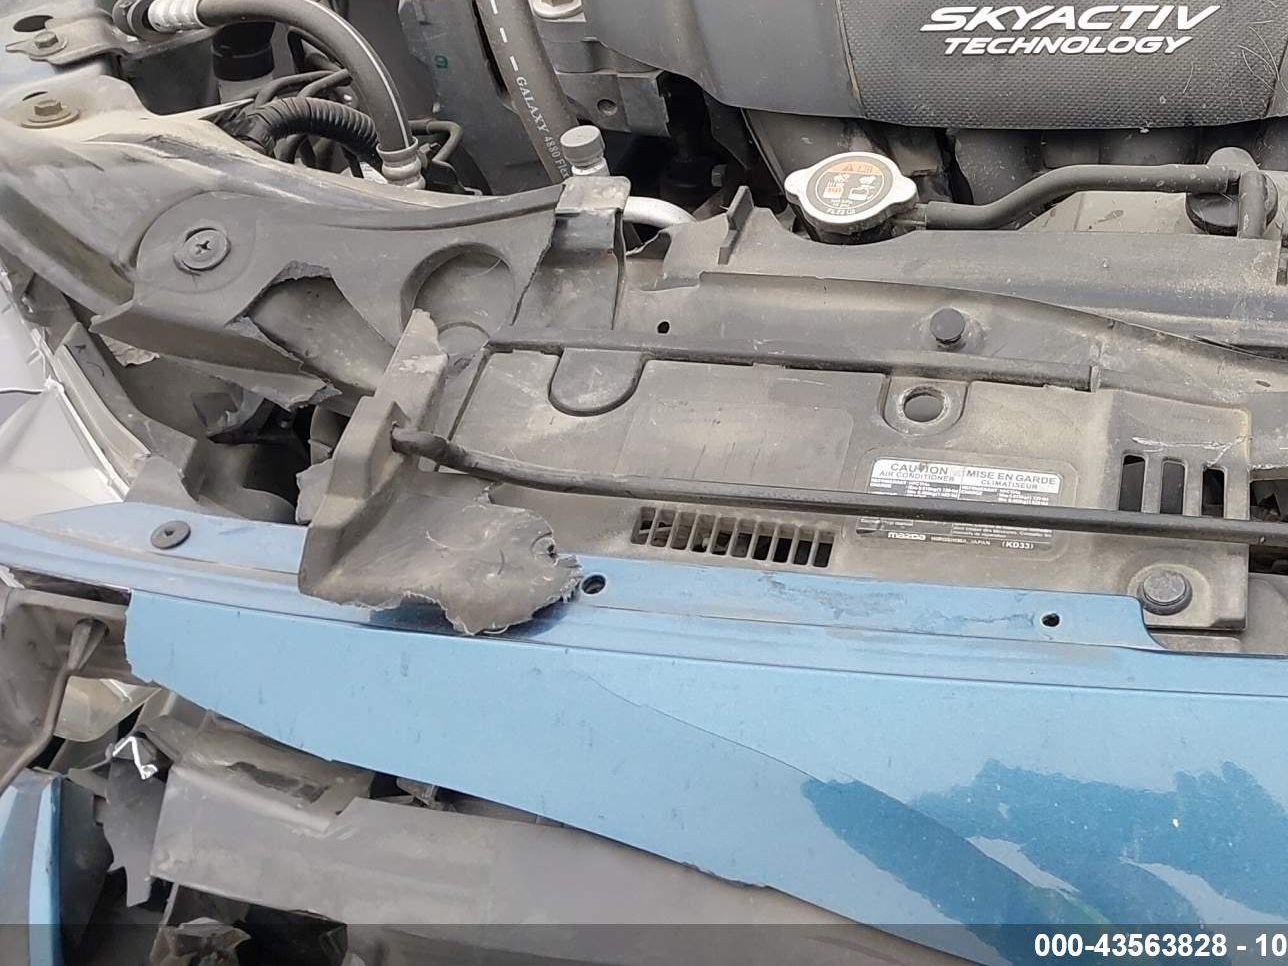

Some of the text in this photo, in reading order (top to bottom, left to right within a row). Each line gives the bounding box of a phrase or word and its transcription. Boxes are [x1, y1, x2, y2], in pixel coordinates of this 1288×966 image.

[920, 5, 1222, 32] SKYACTIV
[944, 36, 1194, 56] TECHNOLOGY
[516, 76, 550, 133] GALAXY
[544, 136, 561, 158] 4880
[896, 472, 955, 482] CONDITIONER
[966, 469, 1056, 485] MISE EN GARDE
[981, 479, 1038, 490] CLIMATISEUR
[888, 532, 926, 541] mazda
